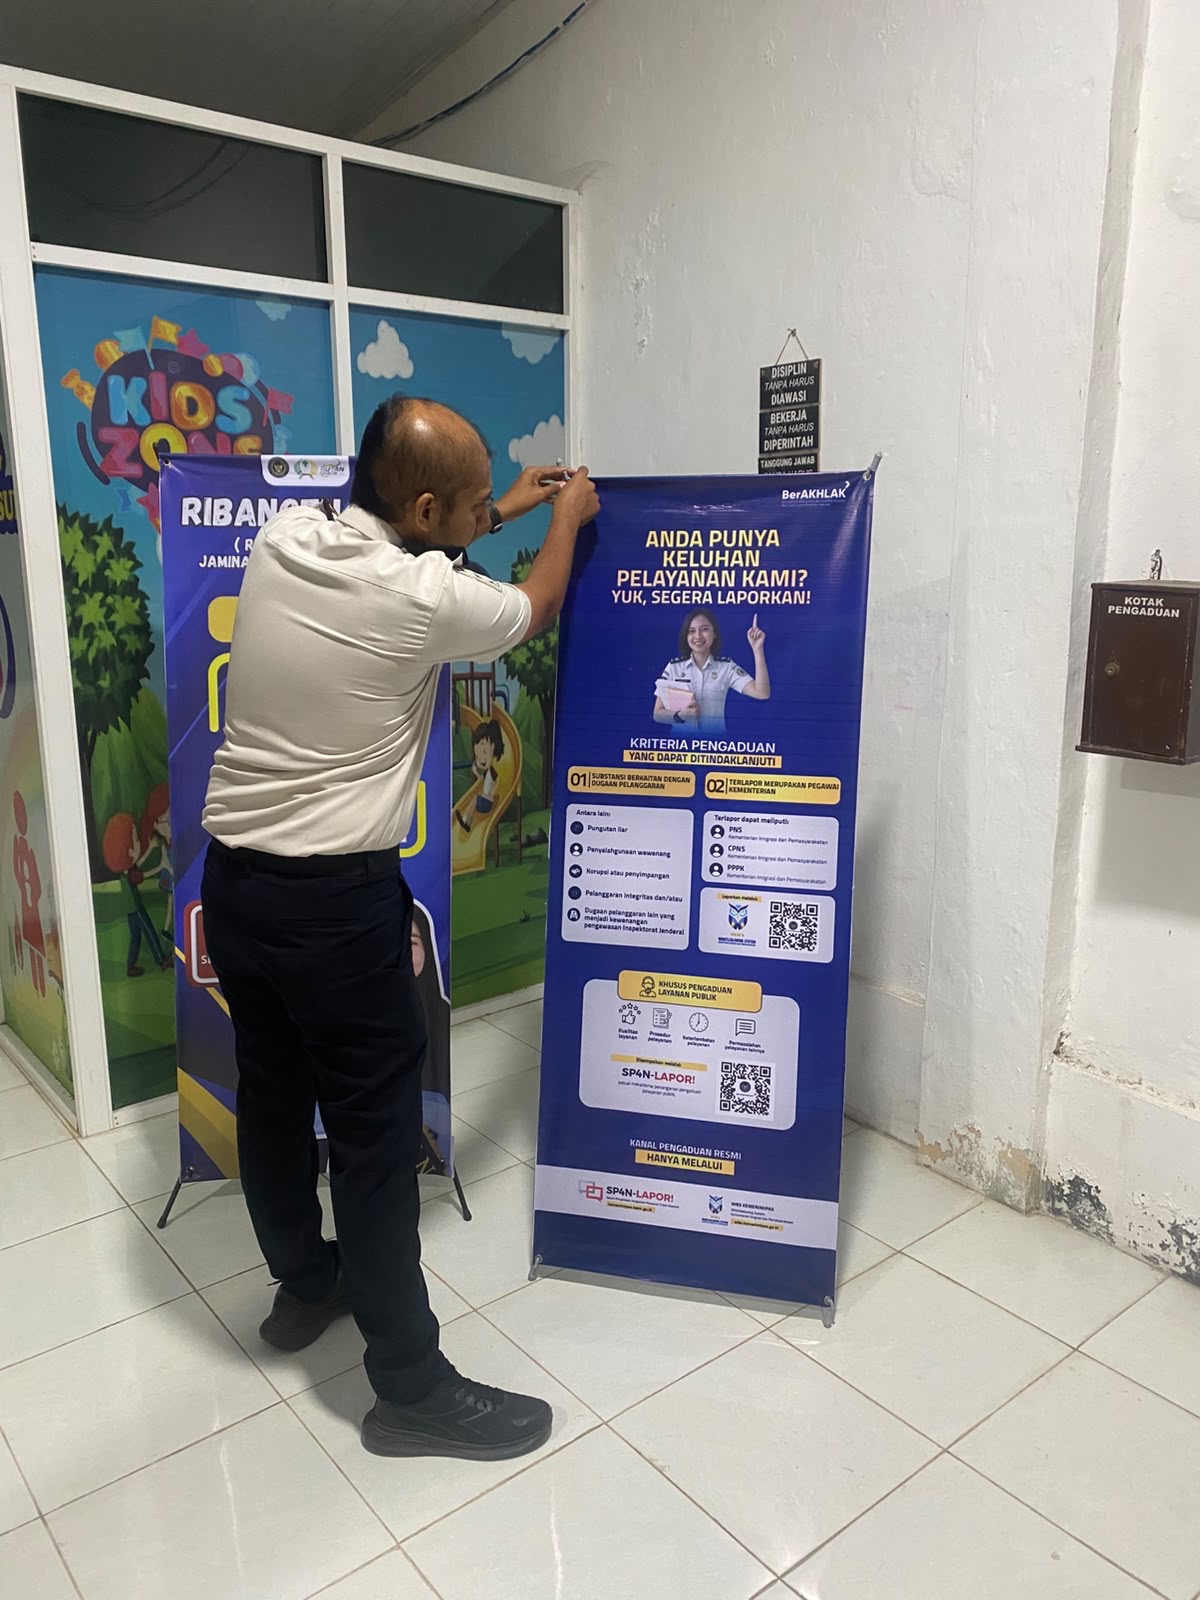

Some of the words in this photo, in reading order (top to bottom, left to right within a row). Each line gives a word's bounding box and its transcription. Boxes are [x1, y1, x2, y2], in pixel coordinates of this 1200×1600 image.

[772, 363, 807, 378] DISIPLIN
[765, 380, 788, 391] TANPA
[789, 376, 814, 388] HARUS
[107, 371, 252, 434] KIDS
[771, 390, 806, 405] DIAWASI
[771, 409, 807, 424] BEKERJA
[765, 426, 788, 436] TANPA
[789, 422, 814, 434] HARUS
[764, 435, 813, 451] DIPERINTAH
[760, 458, 792, 468] TANGGUNG
[794, 456, 815, 465] JAWAB
[782, 484, 848, 499] BerAKHLAK
[646, 530, 703, 547] ANDA
[709, 529, 780, 547] PUNYA
[663, 550, 759, 567] KELUHAN
[617, 570, 735, 587] PELAYANAN
[742, 569, 807, 587] KAMI?
[612, 590, 647, 605] YUK,
[652, 591, 712, 604] SEGERA
[718, 591, 810, 605] LAPORKAN!
[1125, 596, 1164, 607] KOTAK
[1108, 606, 1180, 618] PENGADUAN
[630, 738, 688, 750] KRITERIA
[692, 740, 775, 753] PENGADUAN
[629, 752, 655, 761] YANG
[657, 753, 688, 762] DAPAT
[691, 754, 776, 766] DITINDAKLANJUTI
[571, 773, 586, 786] 01
[592, 772, 626, 780] SUBSTANSI
[627, 774, 662, 782] BERKAITAN
[592, 780, 618, 788] DUGAAN
[729, 779, 762, 787] TERLAPOR
[707, 779, 724, 793] 02
[729, 786, 776, 794] KEMENTERIAN
[715, 815, 740, 823] Terlapor
[741, 816, 759, 824] dapat
[587, 825, 616, 834] Pungutan
[587, 846, 636, 856] Penyalahgunaan
[637, 850, 671, 858] wewenang
[586, 868, 609, 876] Korupsi
[625, 871, 670, 880] penyimpangan
[585, 890, 622, 899] Pelanggaran
[624, 892, 653, 901] integritas
[654, 894, 683, 902] dan/atau
[585, 907, 607, 915] Dugaan
[609, 909, 646, 918] pelanggaran
[585, 915, 608, 923] menjadi
[610, 917, 648, 925] kewenangan
[584, 923, 621, 931] pengawasan
[623, 925, 658, 933] Inspektorat
[659, 981, 688, 990] KHUSUS
[689, 983, 732, 994] PENGADUAN
[659, 989, 689, 998] LAYANAN
[691, 992, 717, 1000] PUBLIK
[622, 1068, 695, 1084] SP4N-LAPOR!
[630, 1139, 657, 1149] KANAL
[659, 1142, 712, 1156] PENGADUAN
[714, 1149, 742, 1160] RESMI
[647, 1153, 679, 1165] HANYA
[681, 1158, 722, 1170] MELALUI
[606, 1186, 674, 1202] SP4N-LAPOR!
